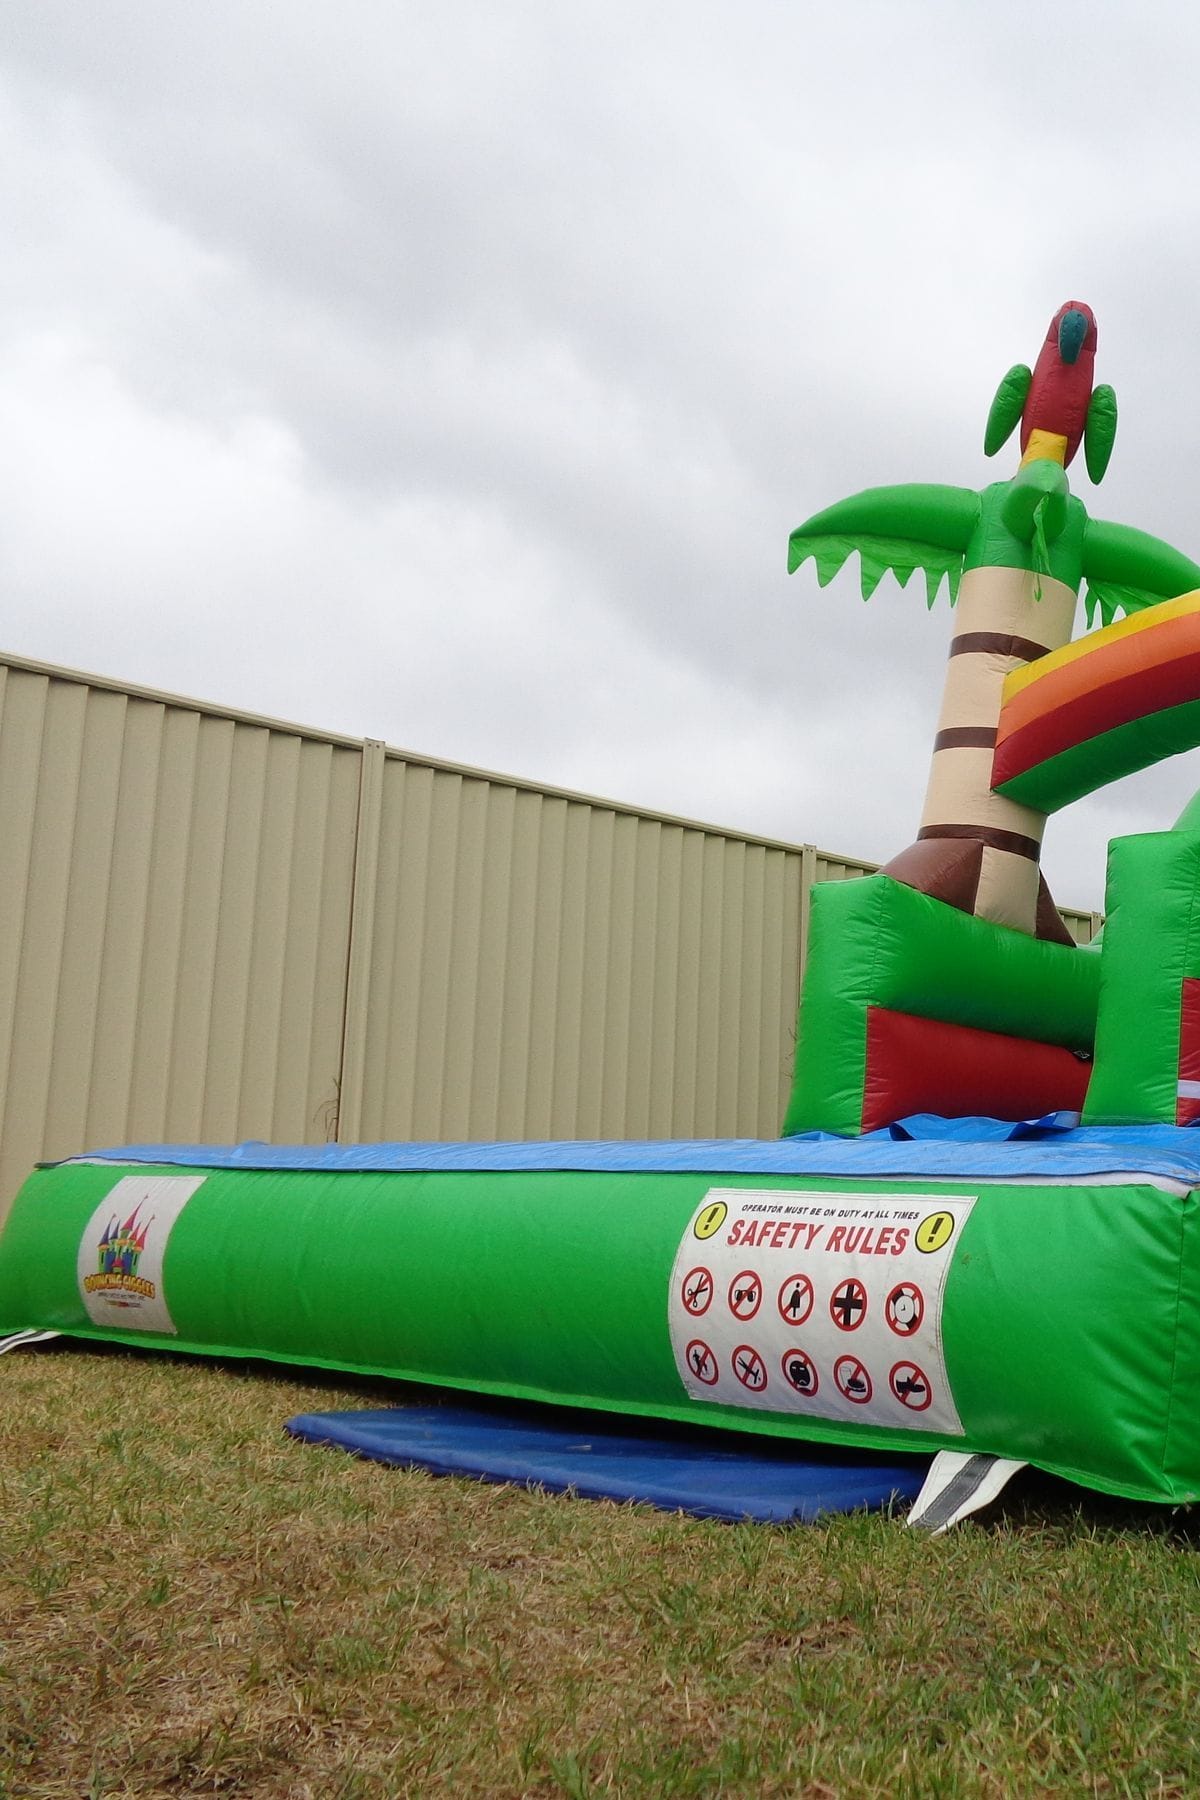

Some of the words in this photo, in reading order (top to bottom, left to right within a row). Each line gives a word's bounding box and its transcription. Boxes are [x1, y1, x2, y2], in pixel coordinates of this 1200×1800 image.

[741, 1203, 783, 1214] OPERATOR
[784, 1206, 809, 1216] MUST
[810, 1207, 822, 1216] BE
[824, 1208, 836, 1217] ON
[837, 1209, 861, 1219] DUTY
[861, 1210, 873, 1219] AT
[874, 1210, 889, 1219] ALL
[892, 1211, 920, 1220] TIMES
[727, 1219, 825, 1250] SAFETY
[825, 1225, 911, 1257] RULES
[84, 1273, 122, 1294] BOUNCING
[122, 1275, 155, 1300] GIGGLES
